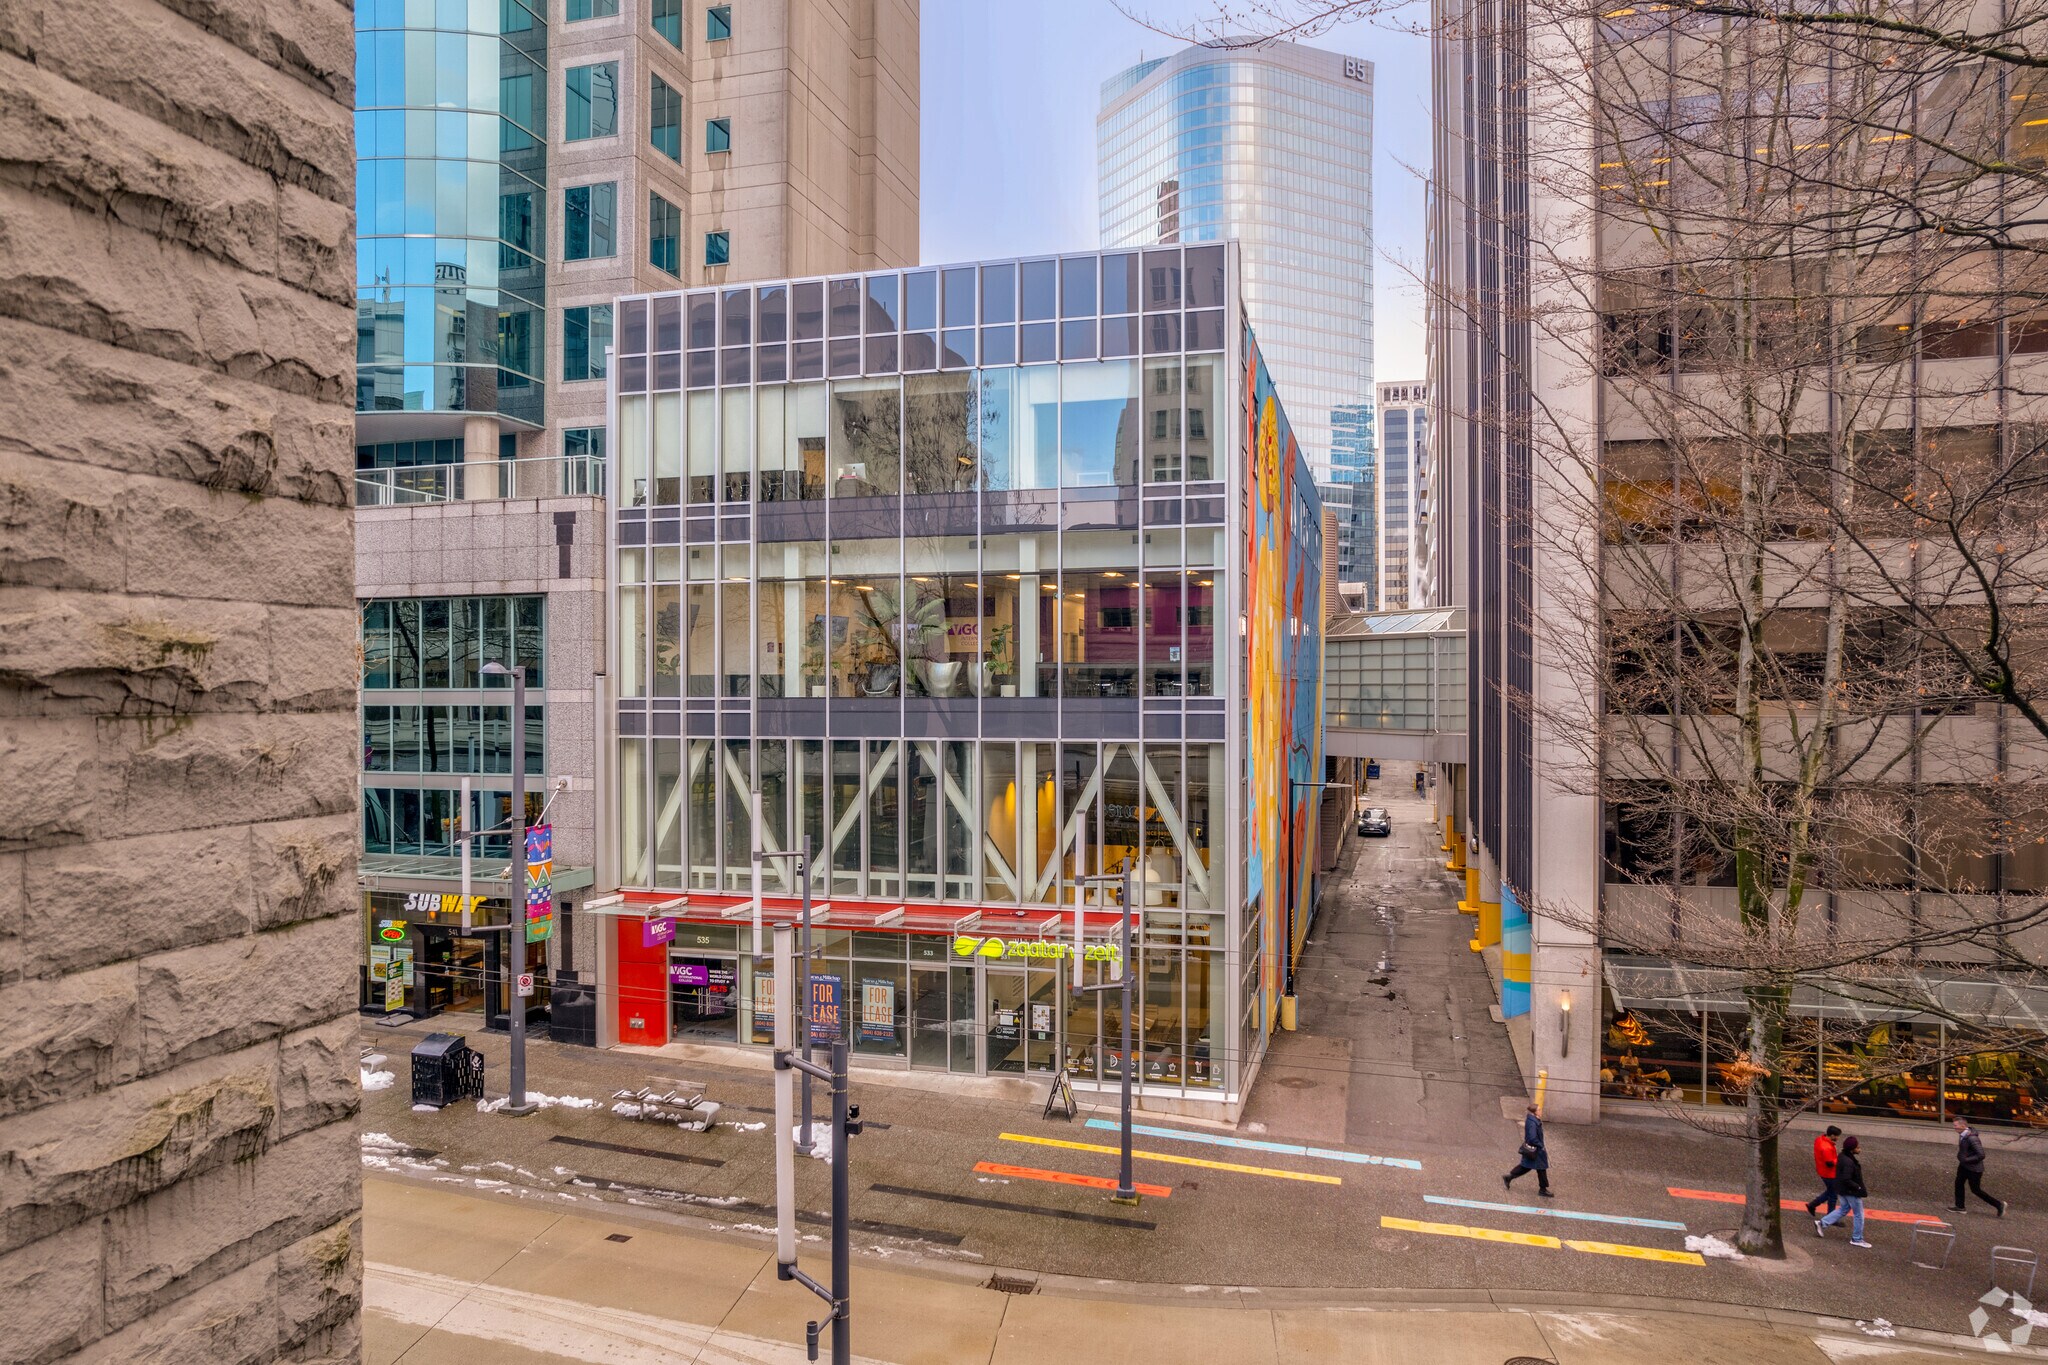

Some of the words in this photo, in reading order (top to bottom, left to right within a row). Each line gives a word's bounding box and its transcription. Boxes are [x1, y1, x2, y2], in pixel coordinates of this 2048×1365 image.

[1345, 58, 1366, 81] B5
[383, 929, 401, 939] OPEN
[448, 928, 458, 936] 541
[696, 936, 710, 944] 535
[1007, 940, 1068, 959] zaatar
[1084, 943, 1120, 961] zeit
[812, 983, 833, 1003] FOR
[869, 987, 887, 1004] FOR
[756, 997, 775, 1014] LEA
[811, 1004, 839, 1024] EASE
[863, 1006, 893, 1023] LEASE
